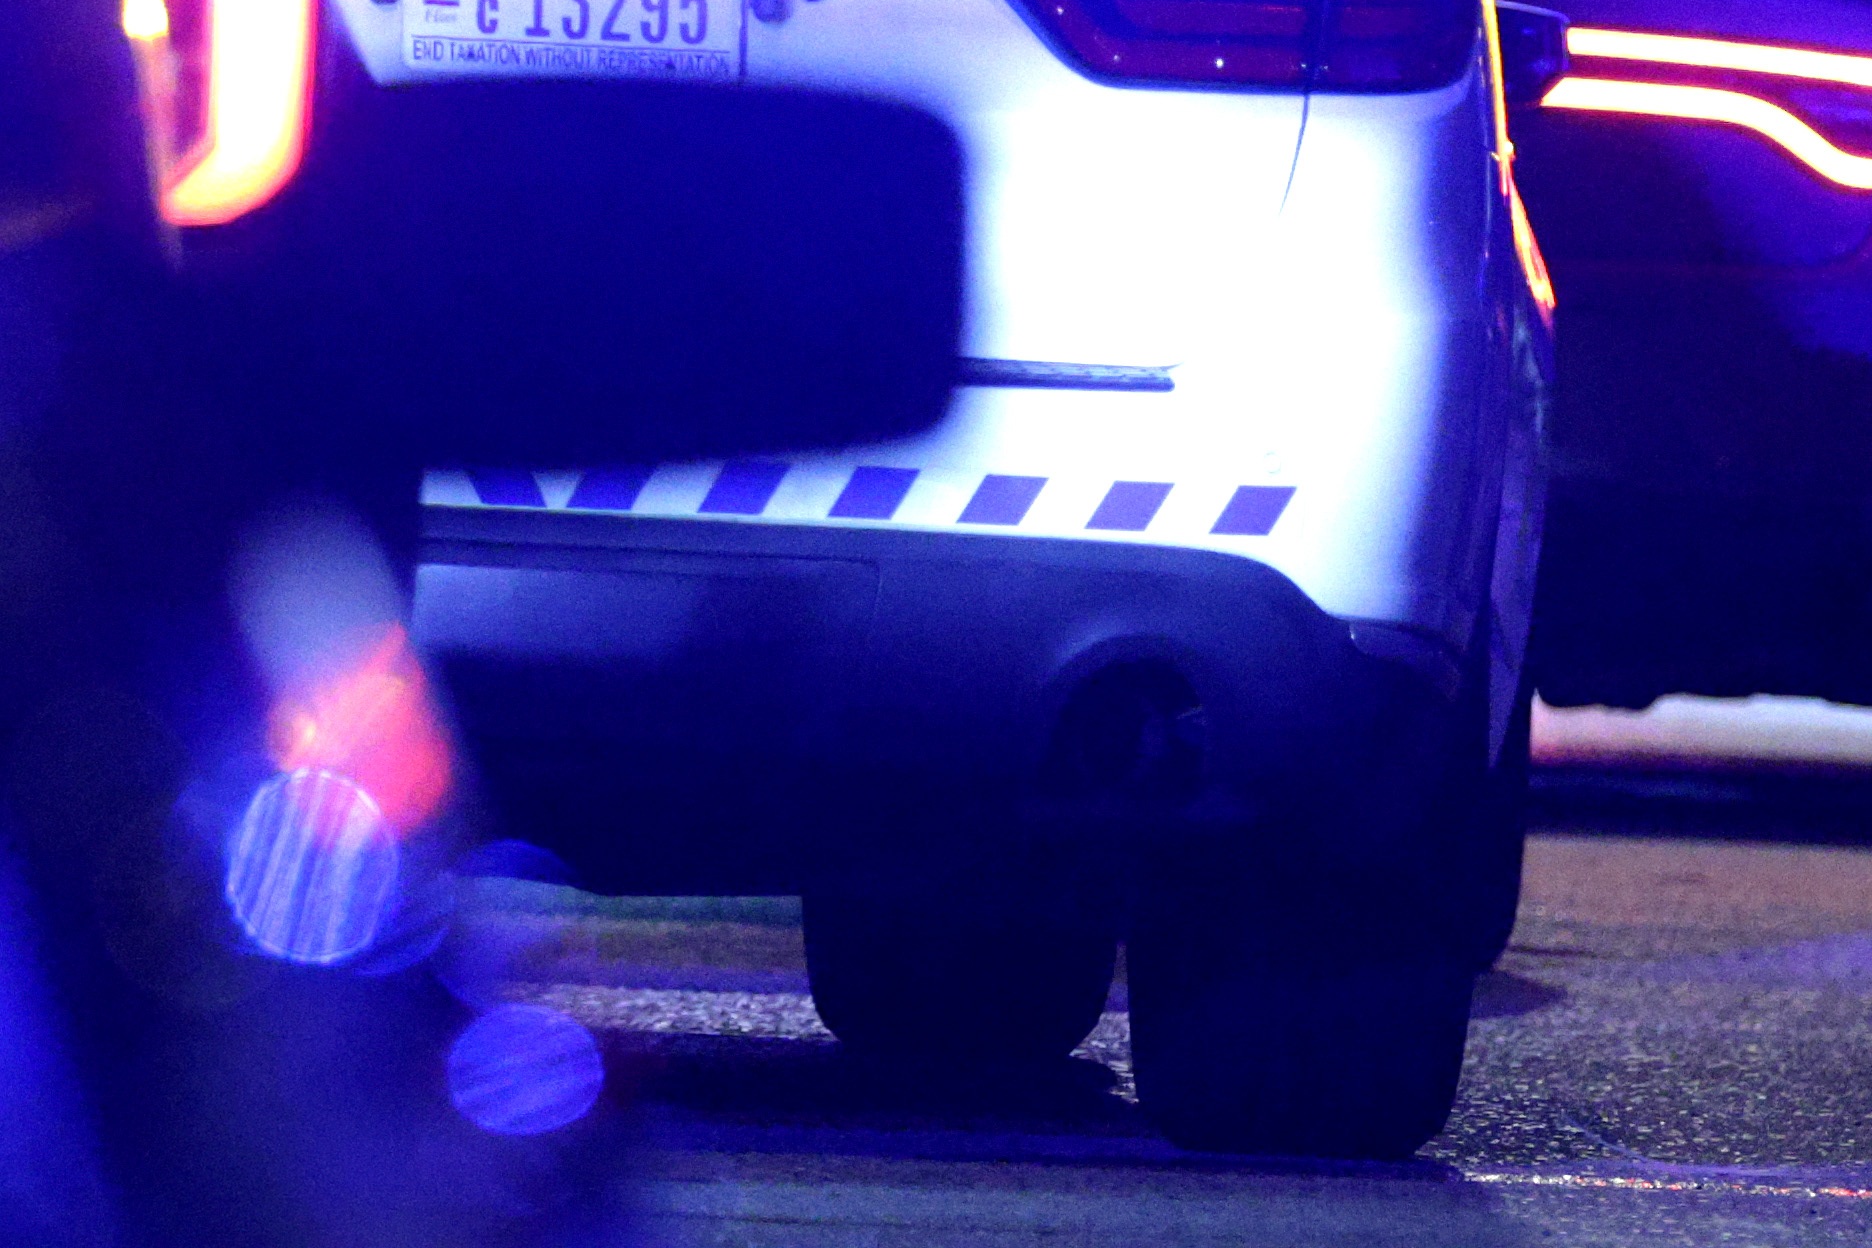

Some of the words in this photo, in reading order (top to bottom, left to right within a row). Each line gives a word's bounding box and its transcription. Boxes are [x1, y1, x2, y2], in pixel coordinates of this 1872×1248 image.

[412, 39, 446, 62] END
[450, 41, 521, 67] TAXATION
[524, 43, 597, 71] WITHOUT
